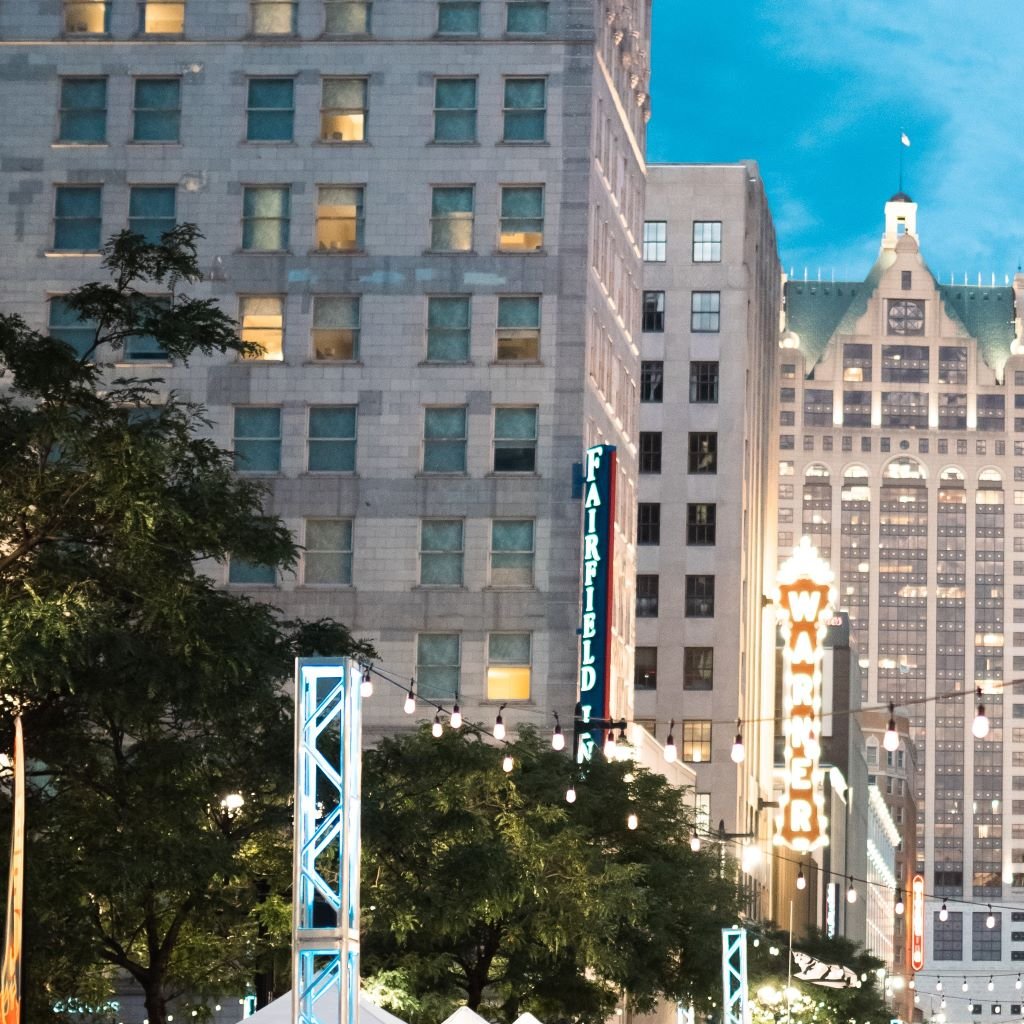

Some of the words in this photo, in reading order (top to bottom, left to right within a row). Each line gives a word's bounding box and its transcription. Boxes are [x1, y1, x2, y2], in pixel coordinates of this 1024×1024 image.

[579, 446, 604, 692] FAIRFIELD
[577, 705, 595, 781] IN
[788, 590, 821, 832] WARNER
